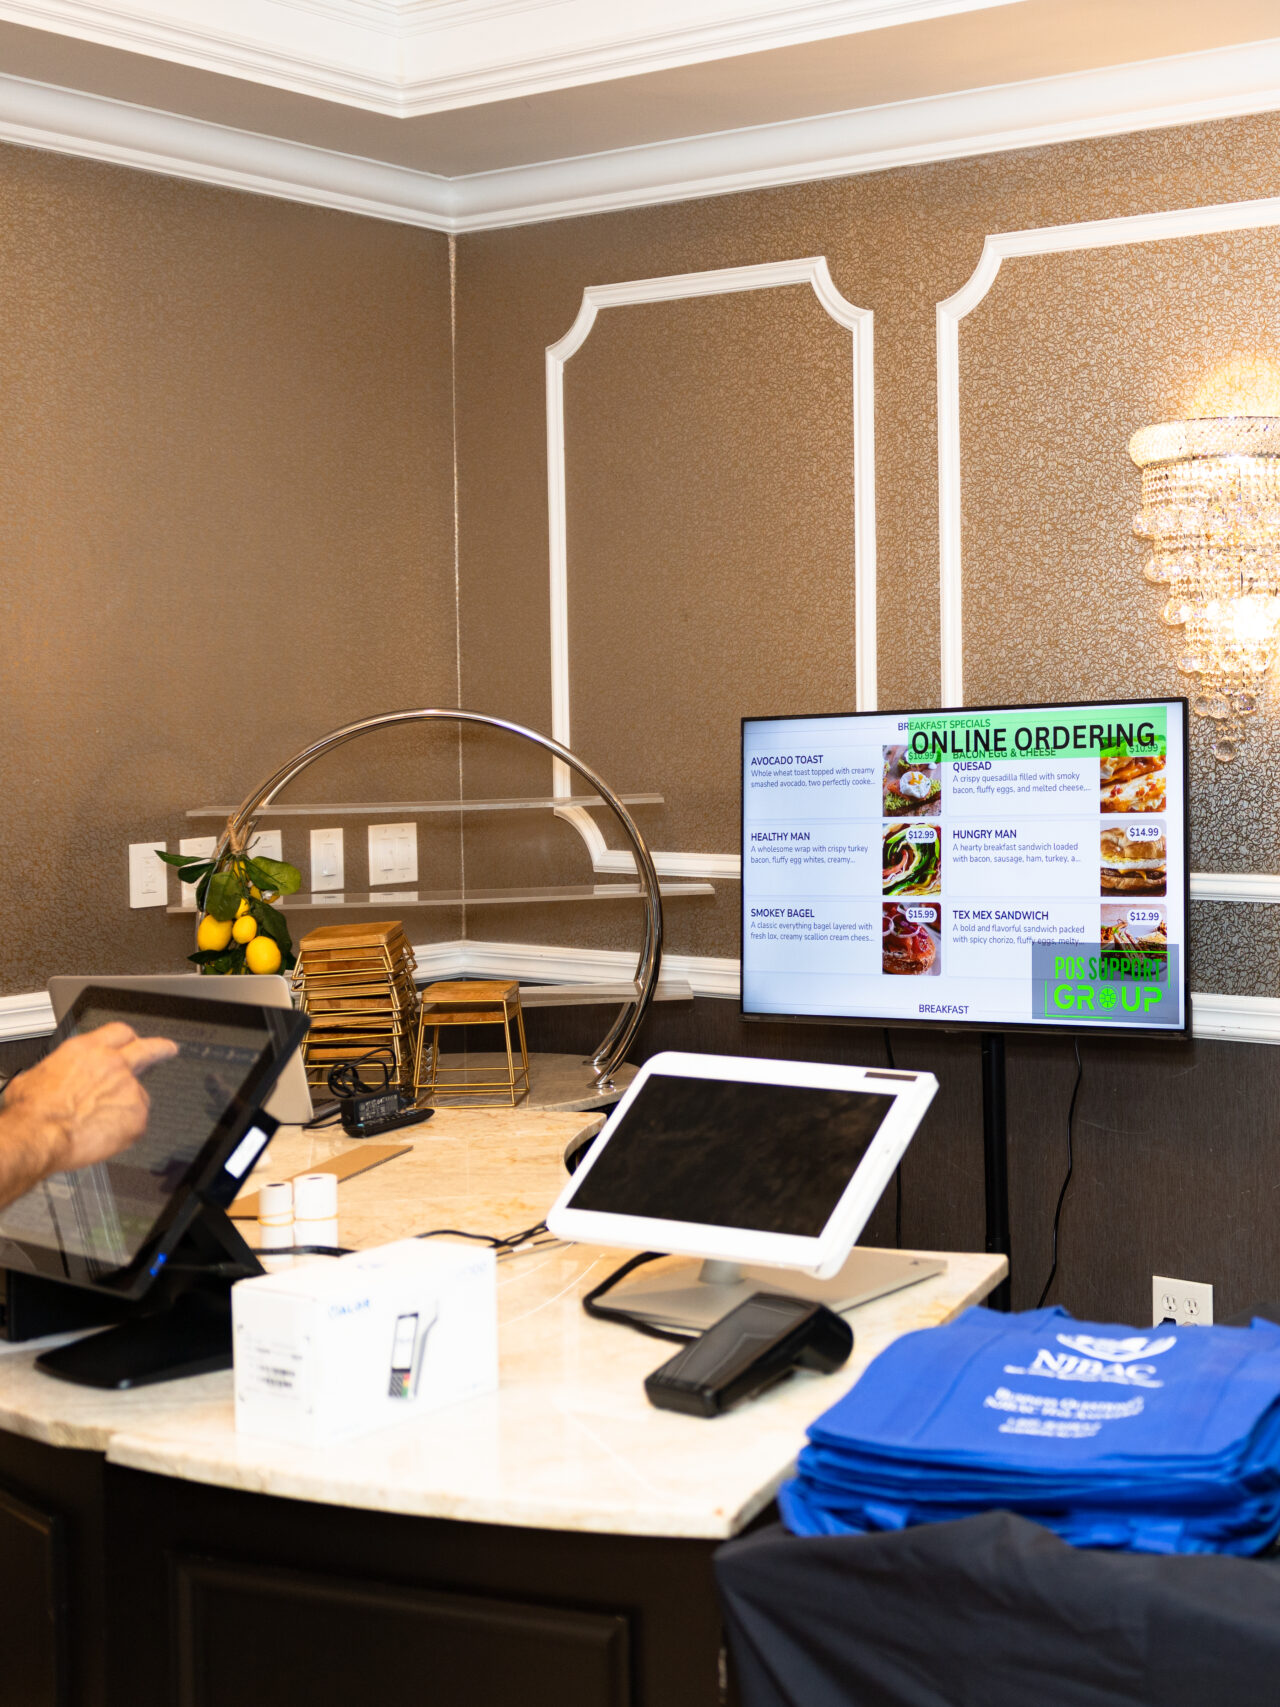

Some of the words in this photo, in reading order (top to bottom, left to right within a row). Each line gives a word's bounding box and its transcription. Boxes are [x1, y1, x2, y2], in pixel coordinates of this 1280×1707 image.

[898, 721, 947, 731] BREAKFAST
[949, 719, 991, 729] SPECIALS
[912, 728, 1006, 753] ONLINE
[1015, 722, 1155, 751] ORDERING
[953, 748, 987, 759] BACON
[989, 748, 1007, 758] EGG
[1010, 748, 1017, 757] &
[1019, 747, 1056, 757] CHEESE
[1129, 743, 1158, 753] $10.99
[751, 756, 793, 766] AVOCADO
[795, 755, 823, 764] TOAST
[908, 752, 934, 760] $10.99
[953, 761, 992, 772] QUESAD
[751, 769, 772, 777] Whole
[773, 768, 792, 776] wheat
[811, 768, 834, 777] topped
[851, 768, 874, 776] creamy
[961, 774, 980, 783] crispy
[982, 773, 1018, 783] quesadilla
[1019, 773, 1037, 781] filled
[1039, 772, 1055, 780] with
[1057, 772, 1080, 782] smoky
[751, 780, 778, 788] smashed
[780, 779, 807, 787] avocado,
[823, 778, 852, 787] perfectly
[953, 786, 975, 795] bacon,
[977, 785, 995, 794] fluffy
[997, 786, 1016, 794] eggs,
[1033, 784, 1057, 792] melted
[1059, 784, 1092, 792] cheese,...
[751, 832, 789, 841] HEALTHY
[790, 832, 810, 840] MAN
[908, 831, 934, 839] $12.99
[953, 830, 992, 839] HUNGRY
[995, 829, 1017, 838] MAN
[1129, 828, 1159, 837] $14.99
[757, 845, 793, 853] wholesome
[794, 846, 813, 854] wrap
[828, 845, 846, 854] crispy
[848, 845, 868, 854] turkey
[960, 844, 982, 853] hearty
[984, 843, 1016, 851] breakfast
[1018, 842, 1052, 851] sandwich
[772, 856, 788, 865] fluffy
[803, 856, 826, 864] whites,
[969, 855, 992, 863] bacon,
[994, 856, 1024, 864] sausage,
[1026, 855, 1043, 863] ham,
[1045, 855, 1069, 864] turkey,
[751, 909, 785, 918] SMOKEY
[787, 909, 814, 918] BAGEL
[908, 910, 934, 919] $15.99
[953, 911, 971, 920] TEX
[973, 911, 992, 920] MEX
[995, 911, 1049, 920] SANDWICH
[1130, 912, 1159, 921] $12.99
[779, 922, 812, 931] everything
[814, 923, 831, 931] bagel
[833, 923, 856, 931] layered
[960, 924, 975, 932] bold
[992, 924, 1021, 933] flavorful
[1023, 925, 1057, 933] sandwich
[1059, 926, 1084, 934] packed
[768, 933, 778, 941] lox,
[780, 934, 803, 942] creamy
[804, 933, 828, 941] scallion
[970, 936, 987, 945] spicy
[989, 936, 1015, 944] chorizo,
[1017, 937, 1035, 945] fluffy
[1058, 938, 1084, 946] melty...
[1055, 956, 1085, 979] POS
[1088, 958, 1162, 981] SUPPORT
[1054, 984, 1162, 1012] GROUP
[918, 1004, 968, 1015] BREAKFAST
